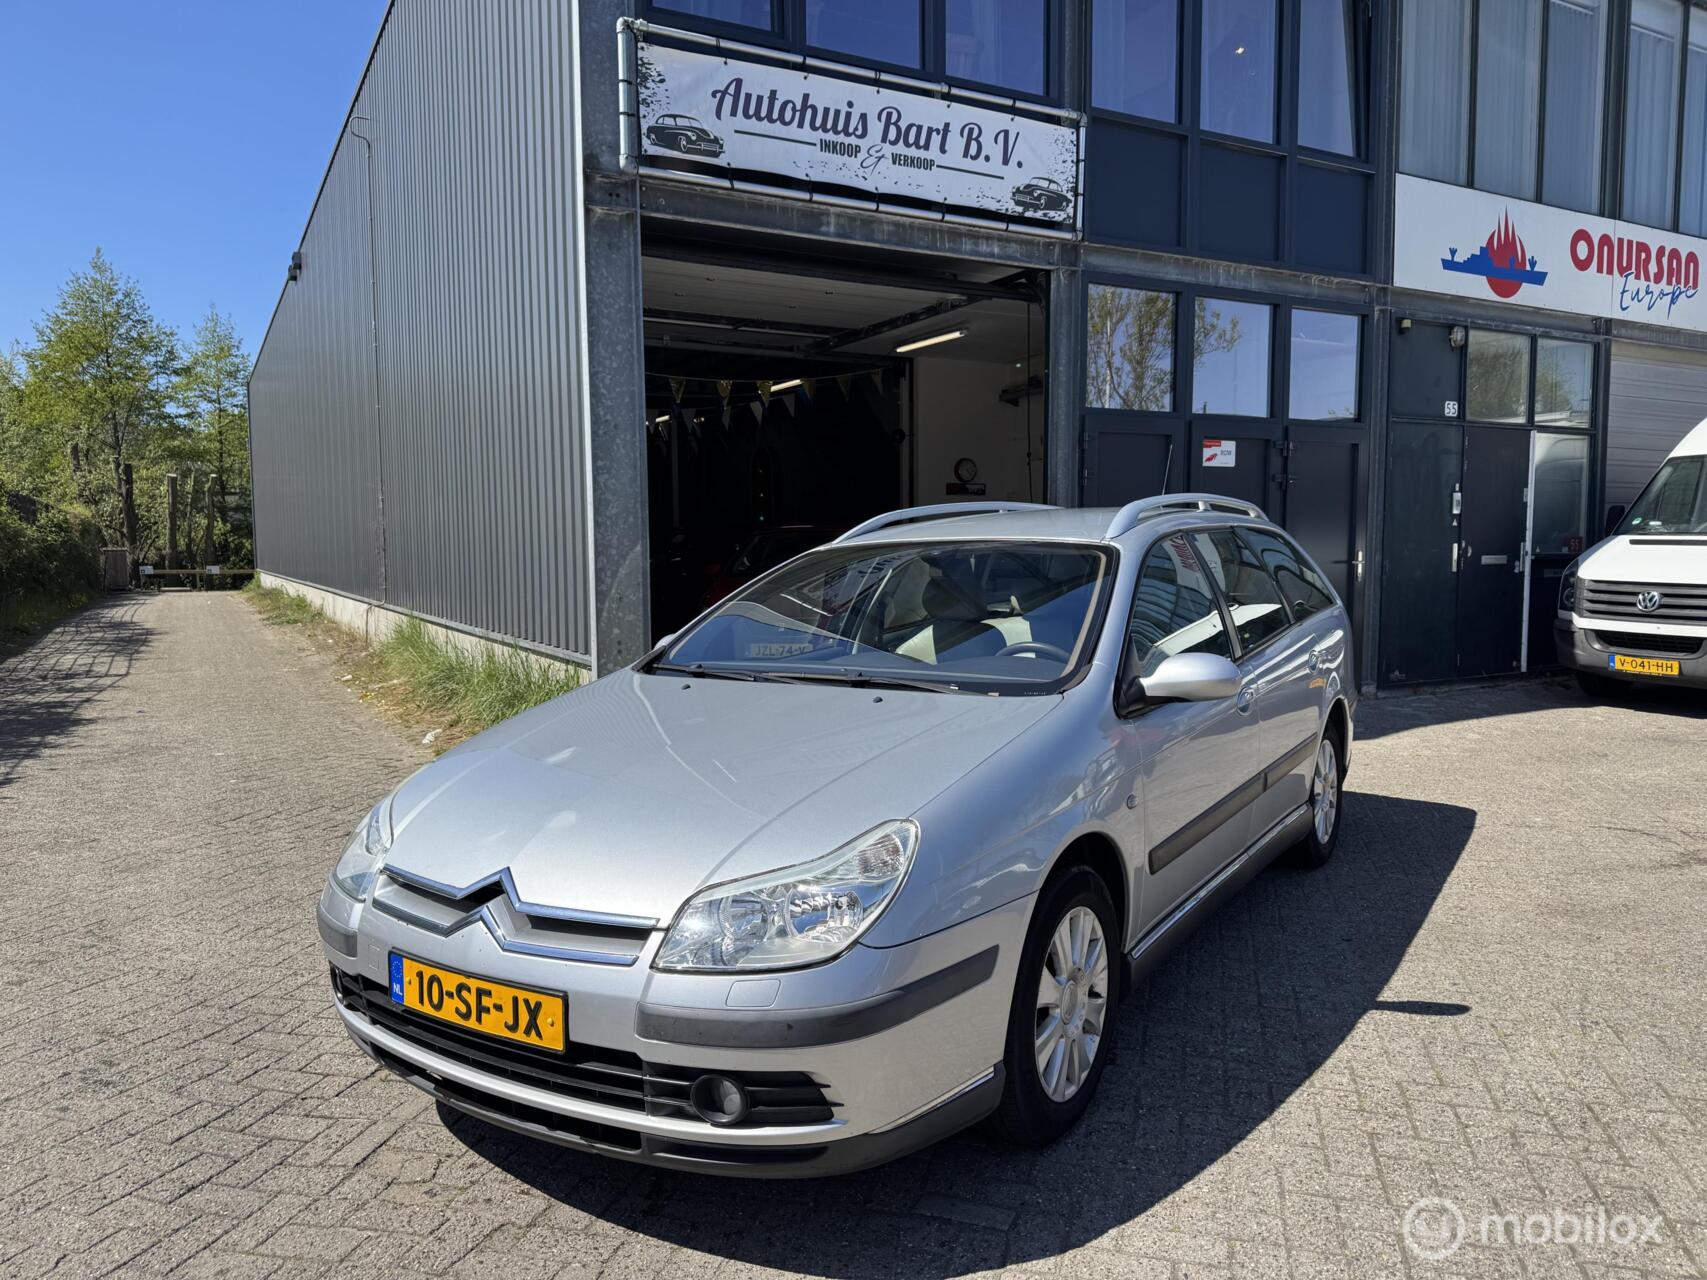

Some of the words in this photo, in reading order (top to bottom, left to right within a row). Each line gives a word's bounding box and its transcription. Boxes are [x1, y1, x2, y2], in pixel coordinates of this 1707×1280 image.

[711, 77, 869, 139] Autohuis
[877, 106, 952, 155] Bart
[959, 122, 1023, 169] B.V.
[819, 138, 862, 159] INKOOP
[860, 144, 889, 176] &
[891, 152, 936, 171] VERKOOP
[1569, 228, 1699, 290] ONURSAN
[1619, 272, 1699, 320] Europe
[1446, 402, 1457, 415] 55
[1619, 657, 1674, 673] V-041-HH
[393, 982, 403, 996] NL
[416, 969, 544, 1041] 10-SF-JX
